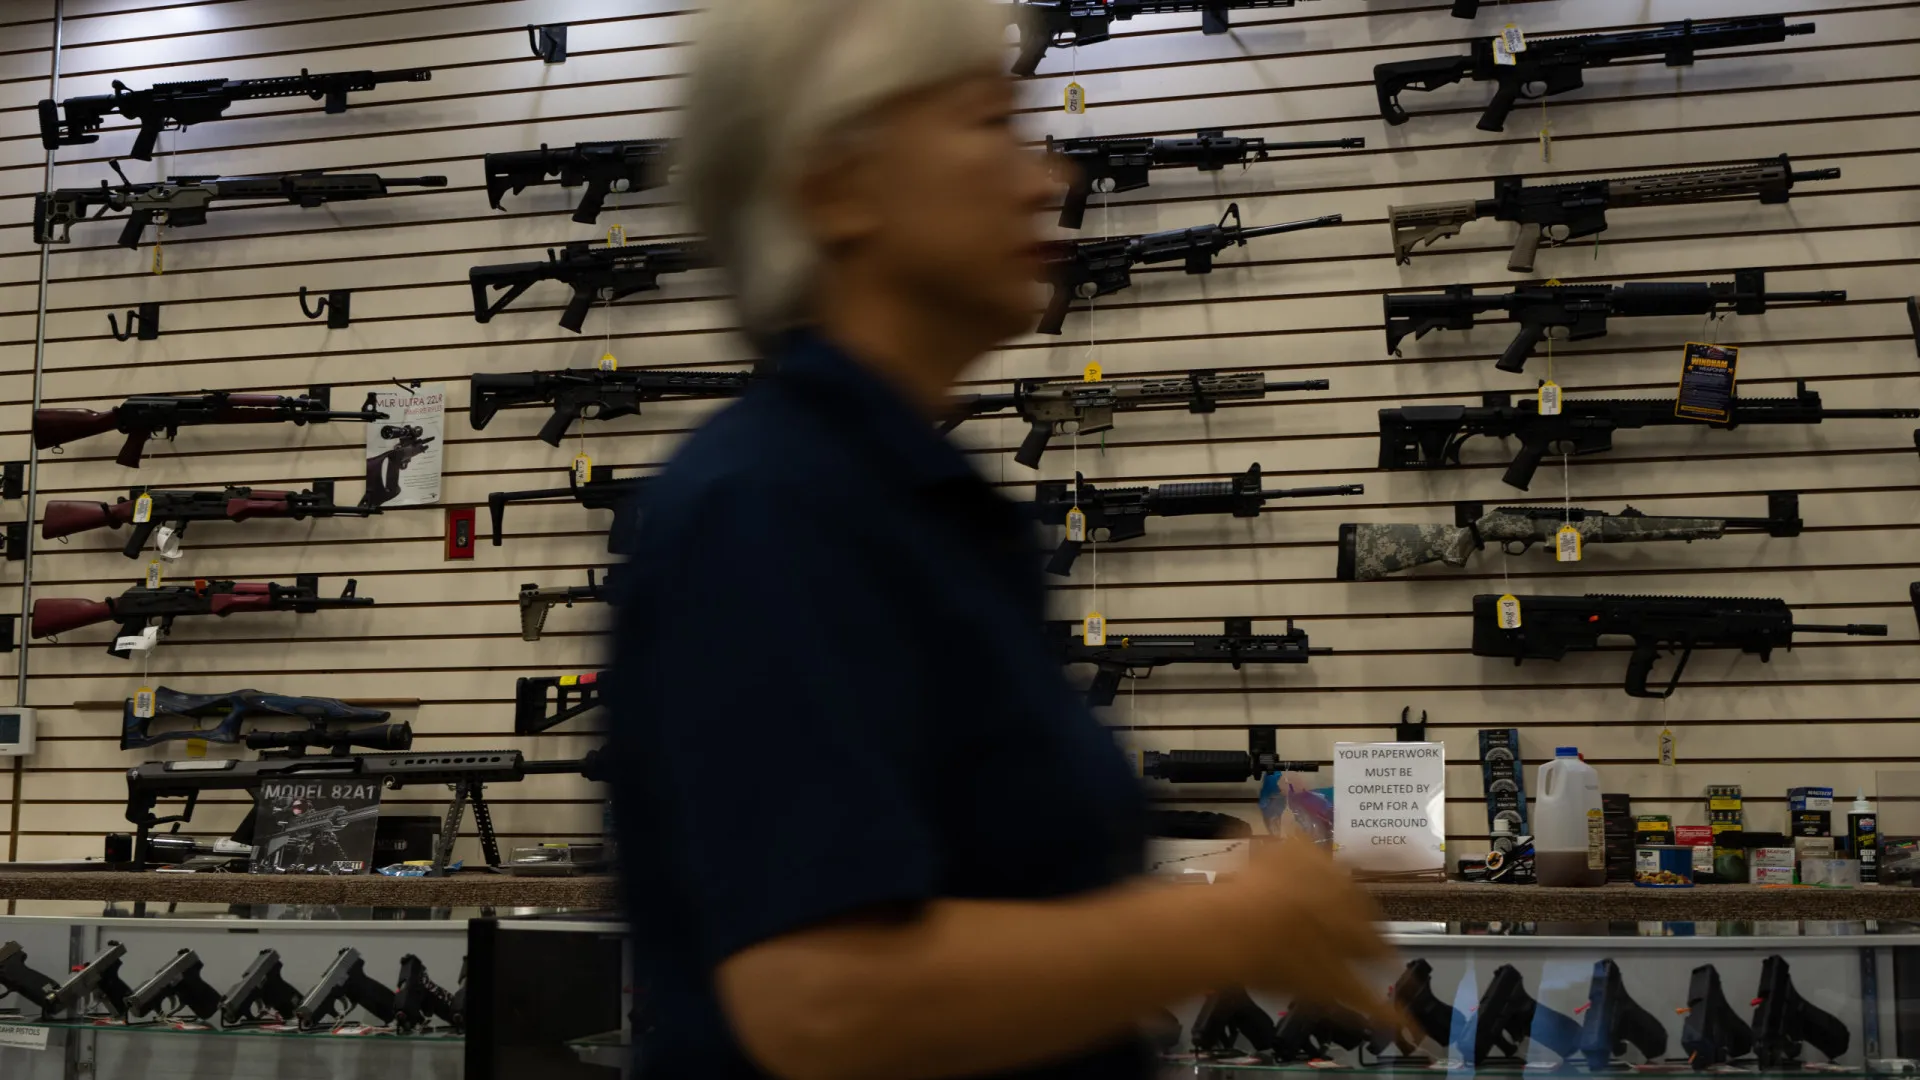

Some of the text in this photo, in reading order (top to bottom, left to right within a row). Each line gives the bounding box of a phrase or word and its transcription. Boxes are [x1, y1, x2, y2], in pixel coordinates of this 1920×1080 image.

[1691, 357, 1729, 368] WINDHAM
[376, 393, 443, 408] MLR ULTRA 22LR
[1339, 749, 1440, 759] YOUR PAPERWORK
[1365, 767, 1413, 777] MUST BE
[264, 784, 376, 800] MODEL 82A1
[1348, 784, 1430, 794] COMPLETED BY
[1359, 801, 1419, 811] 6PM FOR A
[1351, 818, 1428, 828] BACKGROUND
[1371, 835, 1407, 845] CHECK
[16, 1027, 41, 1036] PISTOLS
